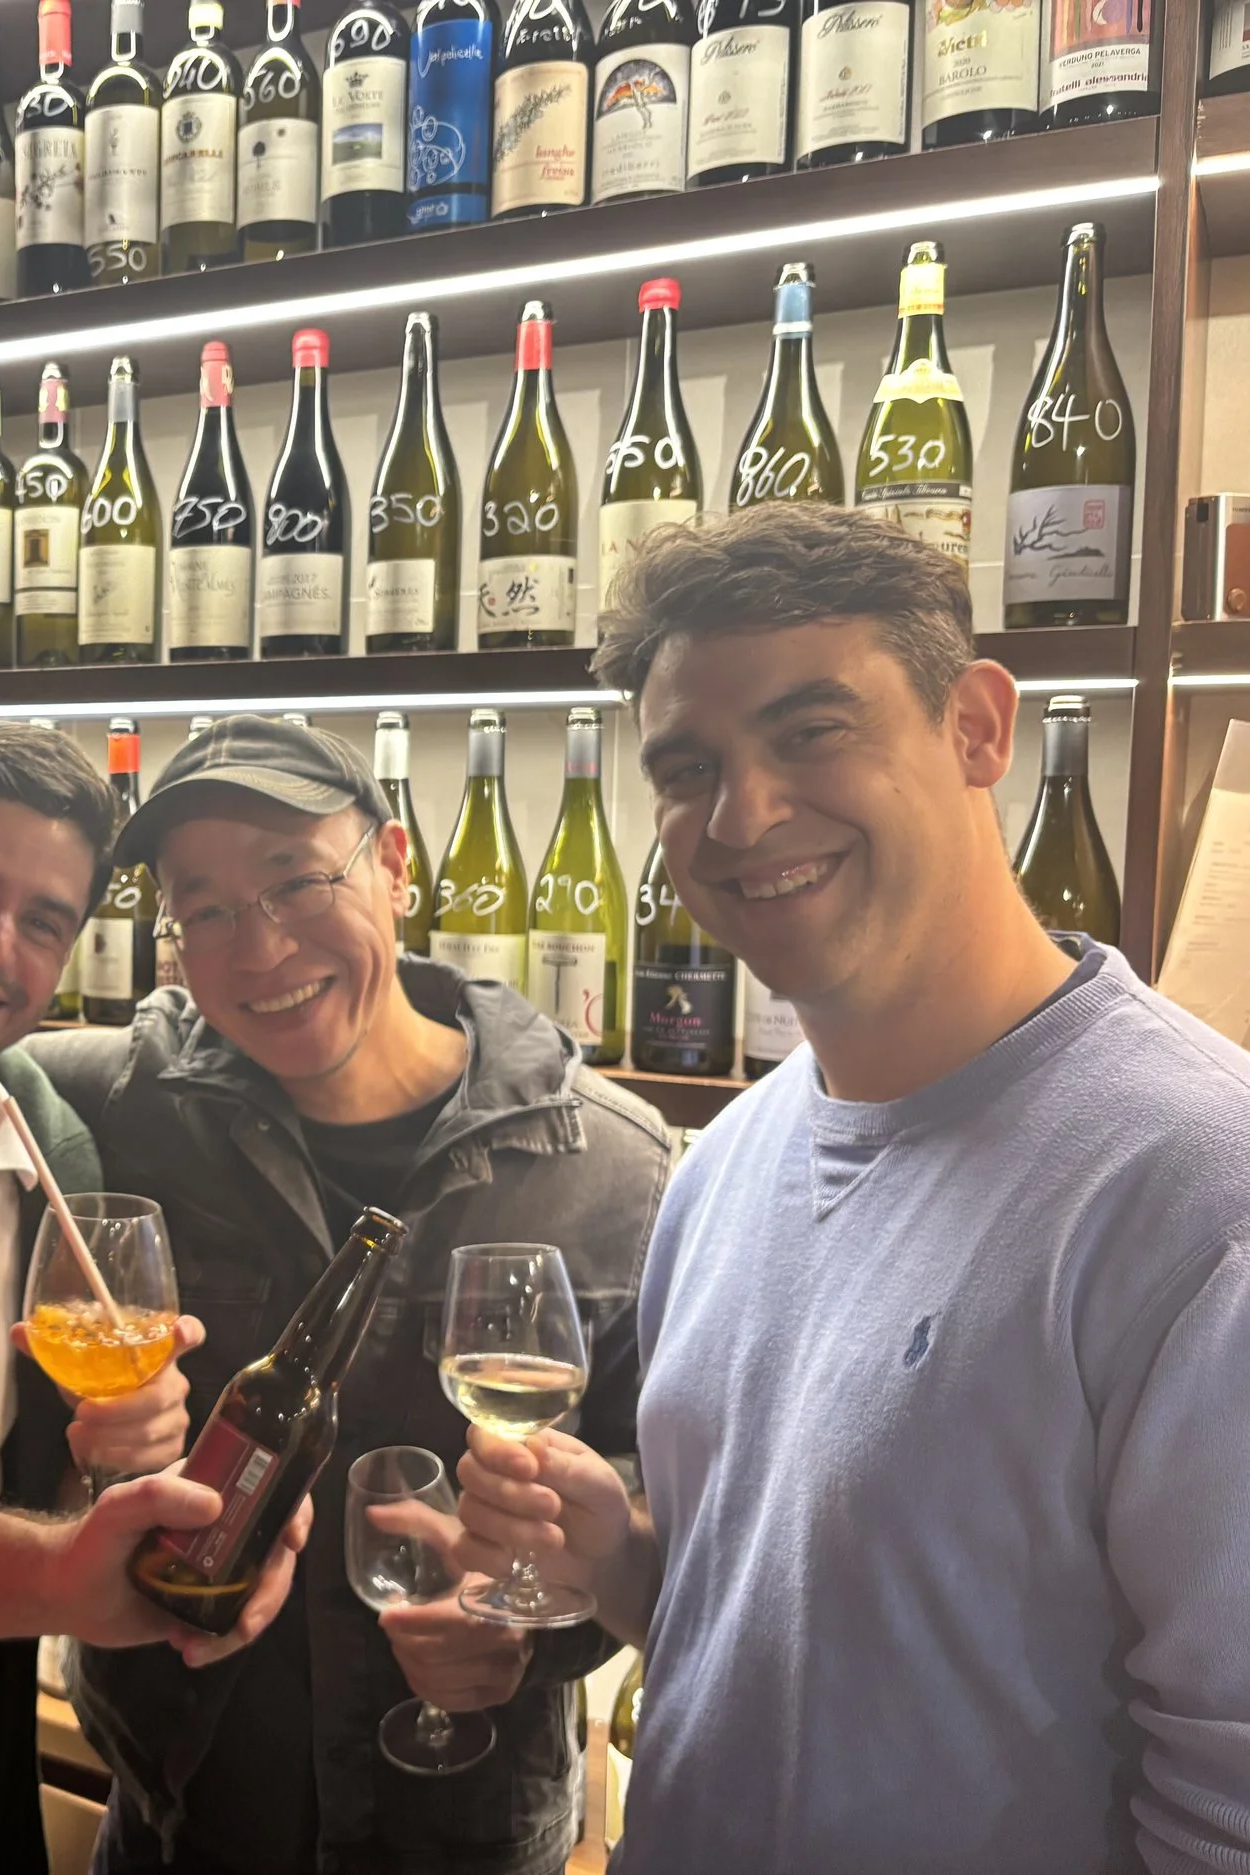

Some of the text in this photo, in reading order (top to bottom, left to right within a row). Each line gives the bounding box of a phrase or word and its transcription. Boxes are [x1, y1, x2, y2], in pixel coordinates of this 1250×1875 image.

[939, 65, 987, 86] BAROLO
[1059, 47, 1141, 68] VERDUNO PELAVERGA
[1027, 391, 1123, 452] 840
[867, 435, 947, 478] 530
[735, 447, 811, 507] 860
[369, 494, 442, 533] 350
[482, 501, 559, 537] 320
[535, 874, 598, 915] 290
[635, 883, 681, 926] 34
[650, 1011, 702, 1028] Morgon
